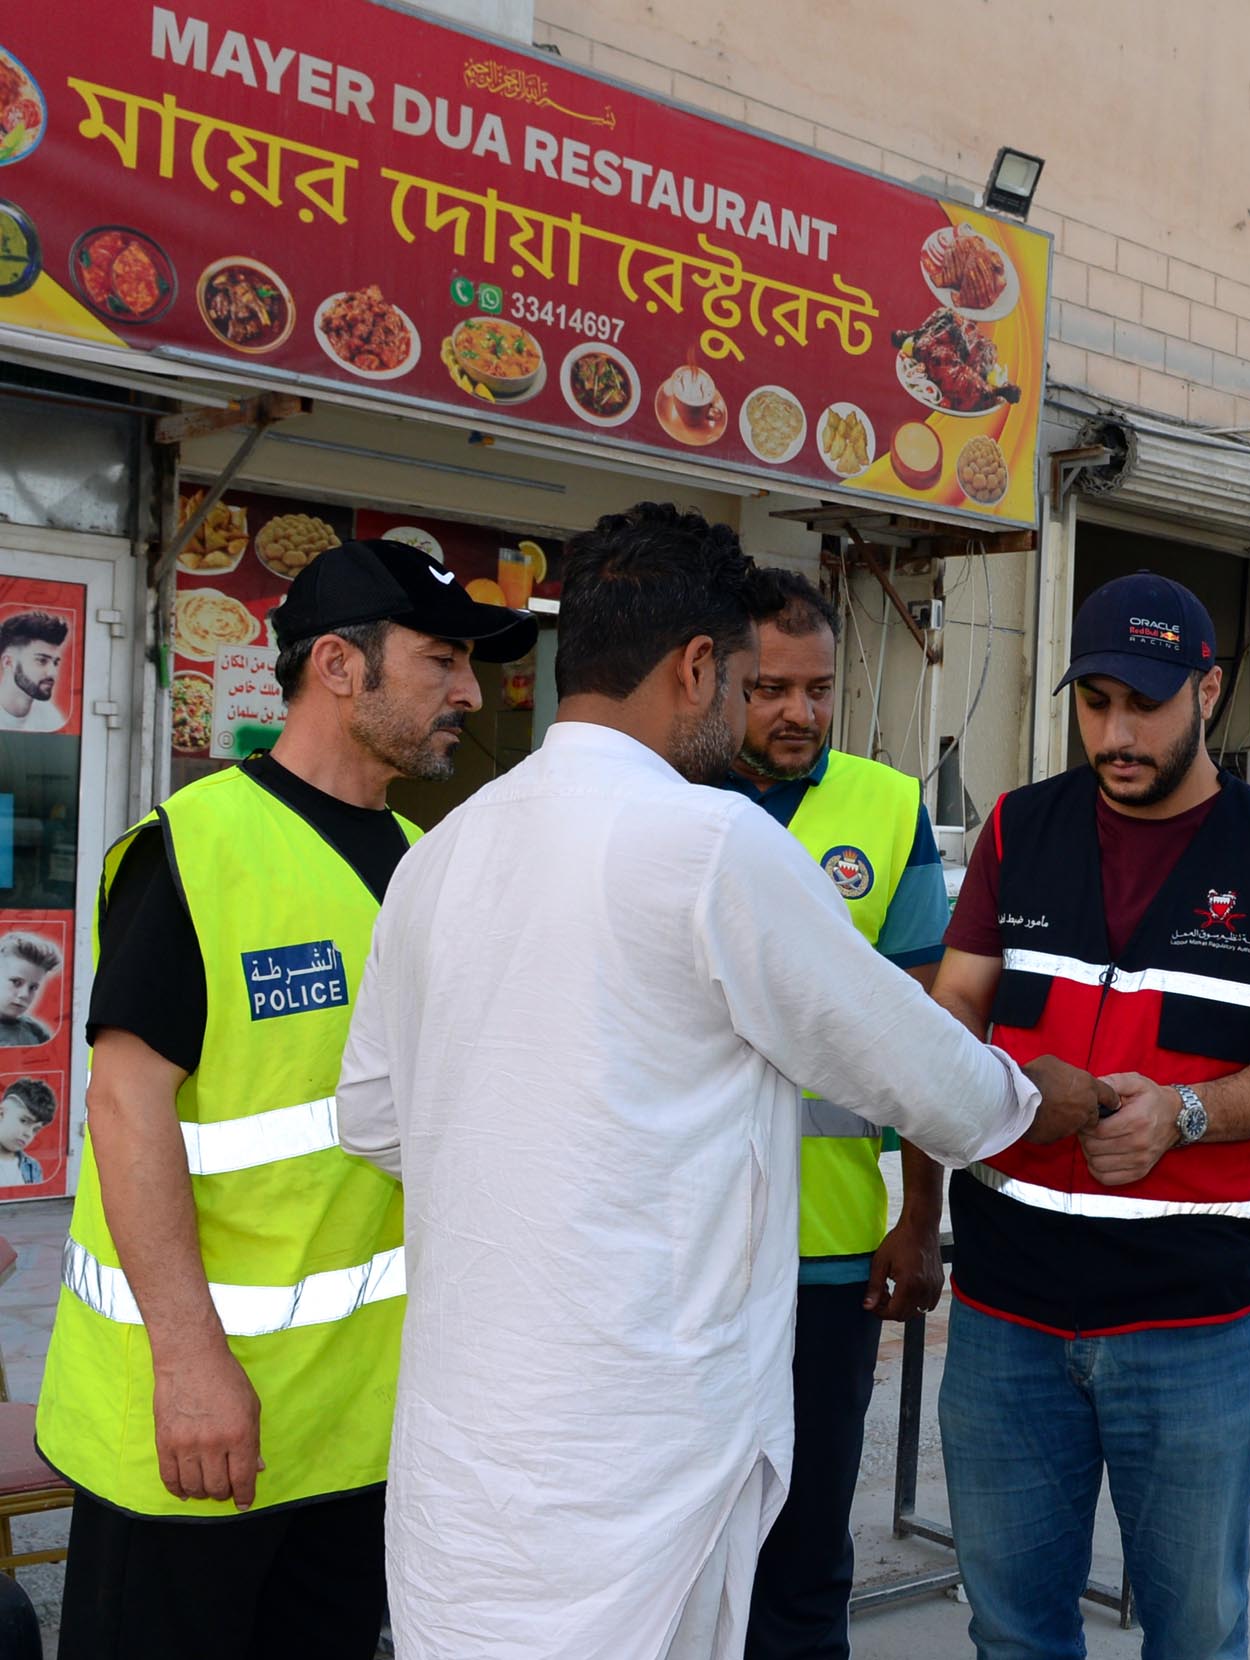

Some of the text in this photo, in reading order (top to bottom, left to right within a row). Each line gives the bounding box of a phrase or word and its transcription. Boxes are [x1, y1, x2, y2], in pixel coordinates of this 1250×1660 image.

[152, 5, 838, 262] MAYER DUA RESTAURANT
[67, 76, 880, 362] মায়ের দোয়া রেস্টুরেন্ট
[510, 291, 626, 344] 33414697
[1129, 617, 1180, 633] ORACLE
[1129, 626, 1159, 637] Red Bull
[1129, 636, 1180, 651] RACING
[221, 654, 248, 670] المكان
[228, 680, 256, 697] خاص
[227, 704, 258, 720] سلمان
[1024, 914, 1049, 929] مأمور
[251, 947, 338, 985] الشرطة
[253, 979, 343, 1015] POLICE
